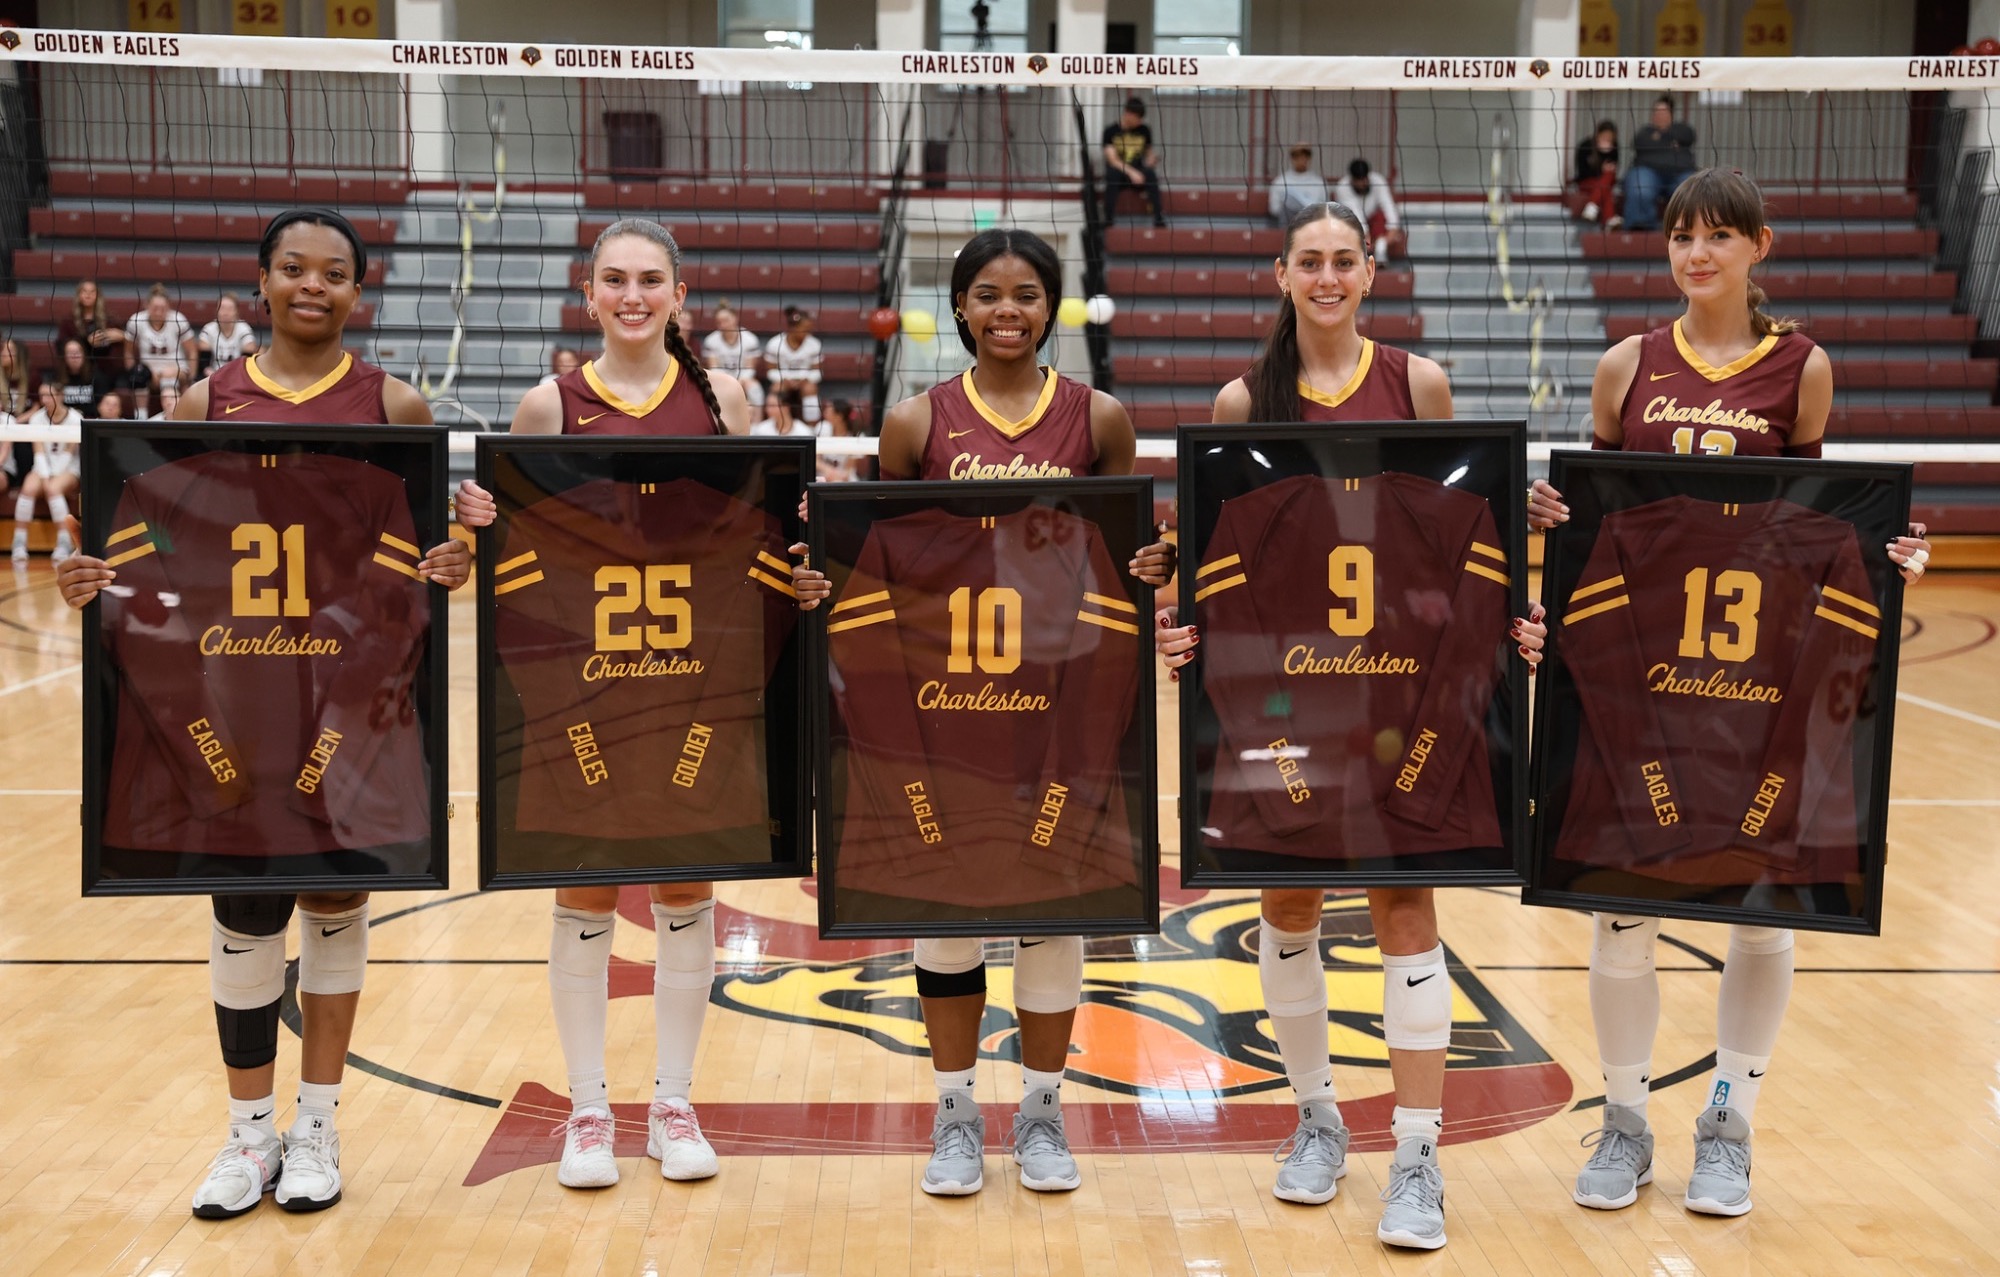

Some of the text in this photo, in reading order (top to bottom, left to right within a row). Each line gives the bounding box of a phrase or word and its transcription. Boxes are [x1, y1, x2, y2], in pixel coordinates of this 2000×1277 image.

[138, 1, 175, 21] 14
[239, 2, 279, 24] 32
[335, 6, 371, 27] 10
[1660, 24, 1699, 45] 23
[1747, 24, 1787, 45] 34
[34, 33, 180, 57] GOLDEN EAGLES
[392, 44, 695, 70] CHARLESTON GOLDEN EAGLES
[902, 55, 1198, 76] CHARLESTON GOLDEN EAGLES
[1403, 60, 1700, 79] CHARLESTON GOLDEN EAGLES
[1643, 395, 1770, 435] Charleston
[231, 523, 310, 617] 21
[1328, 545, 1375, 637] 9
[594, 564, 692, 651] 25
[947, 586, 1023, 674] 10
[1678, 567, 1763, 663] 13
[199, 624, 342, 656] Charleston
[1283, 644, 1420, 675] Charleston
[582, 651, 705, 682] Charleston
[1647, 663, 1783, 703] Charleston
[917, 680, 1051, 712] Charleston
[187, 717, 237, 784] EAGLES
[295, 727, 343, 794] GOLDEN
[566, 721, 609, 786] EAGLES
[672, 722, 713, 788] GOLDEN
[1267, 737, 1311, 804] EAGLES
[1395, 728, 1438, 793] GOLDEN
[904, 780, 942, 845] EAGLES
[1031, 782, 1069, 847] GOLDEN
[1641, 760, 1679, 827] EAGLES
[1740, 772, 1786, 838] GOLDEN
